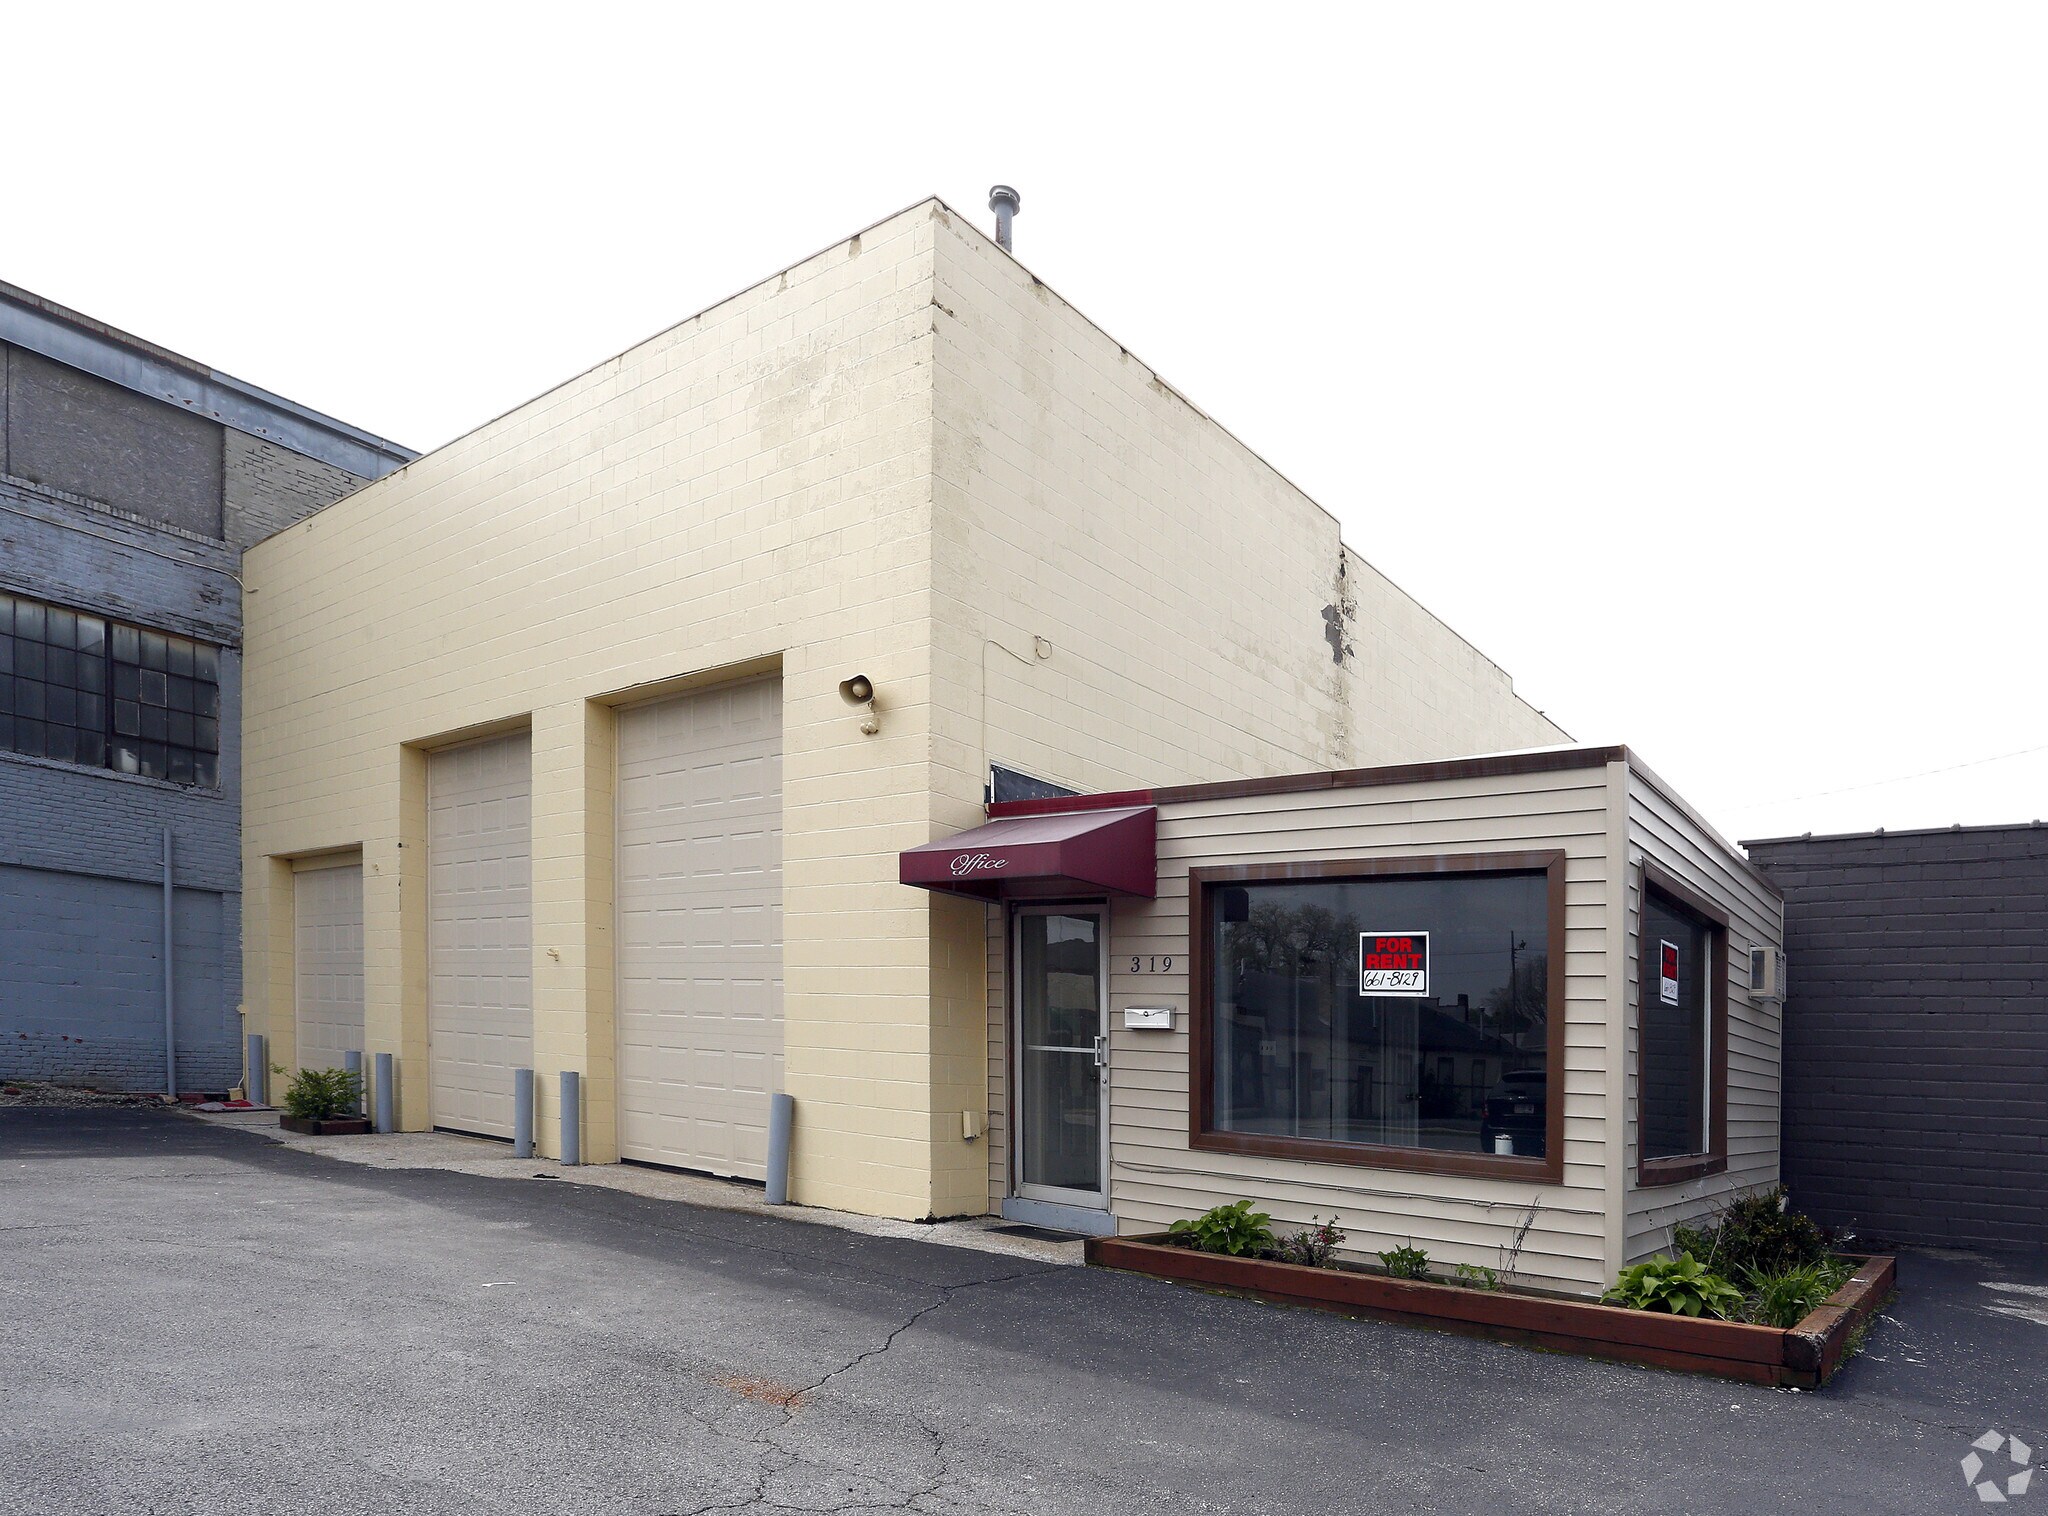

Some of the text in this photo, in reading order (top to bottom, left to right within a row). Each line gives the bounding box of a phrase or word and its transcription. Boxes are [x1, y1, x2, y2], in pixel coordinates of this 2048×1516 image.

[950, 853, 1009, 876] Office
[1375, 938, 1412, 953] FOR
[1130, 956, 1173, 973] 319
[1366, 954, 1422, 969] RENT
[1365, 972, 1419, 987] 661-8129
